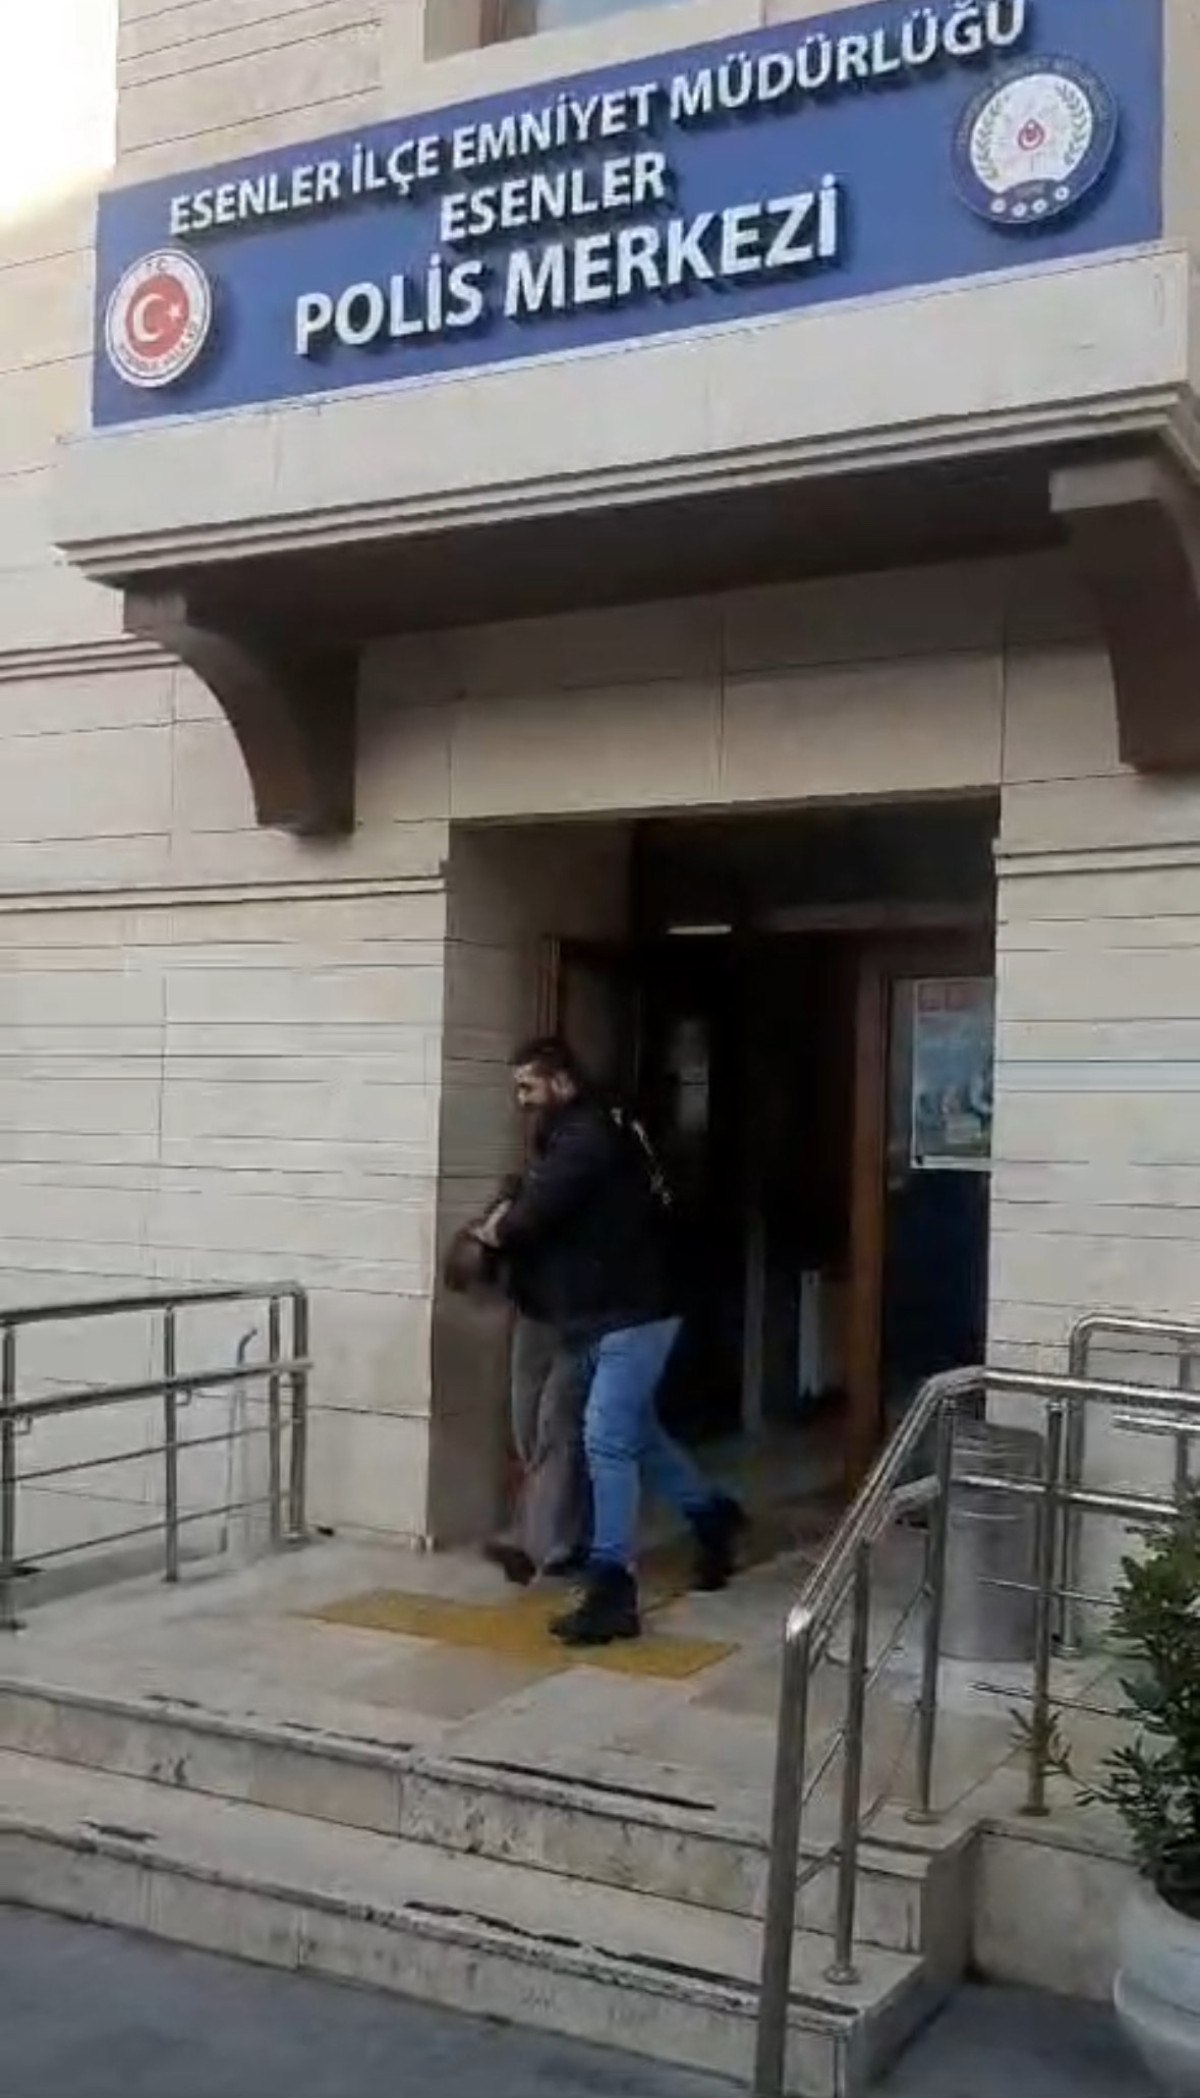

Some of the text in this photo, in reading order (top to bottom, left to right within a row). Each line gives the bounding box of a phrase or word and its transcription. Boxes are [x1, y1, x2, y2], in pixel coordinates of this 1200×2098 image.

[170, 160, 340, 235] ESENLER
[352, 140, 440, 194] İLÇE
[453, 82, 657, 170] EMNİYET
[440, 151, 666, 242] ESENLER
[296, 252, 484, 354] POLİS
[504, 173, 838, 317] MERKEZİ
